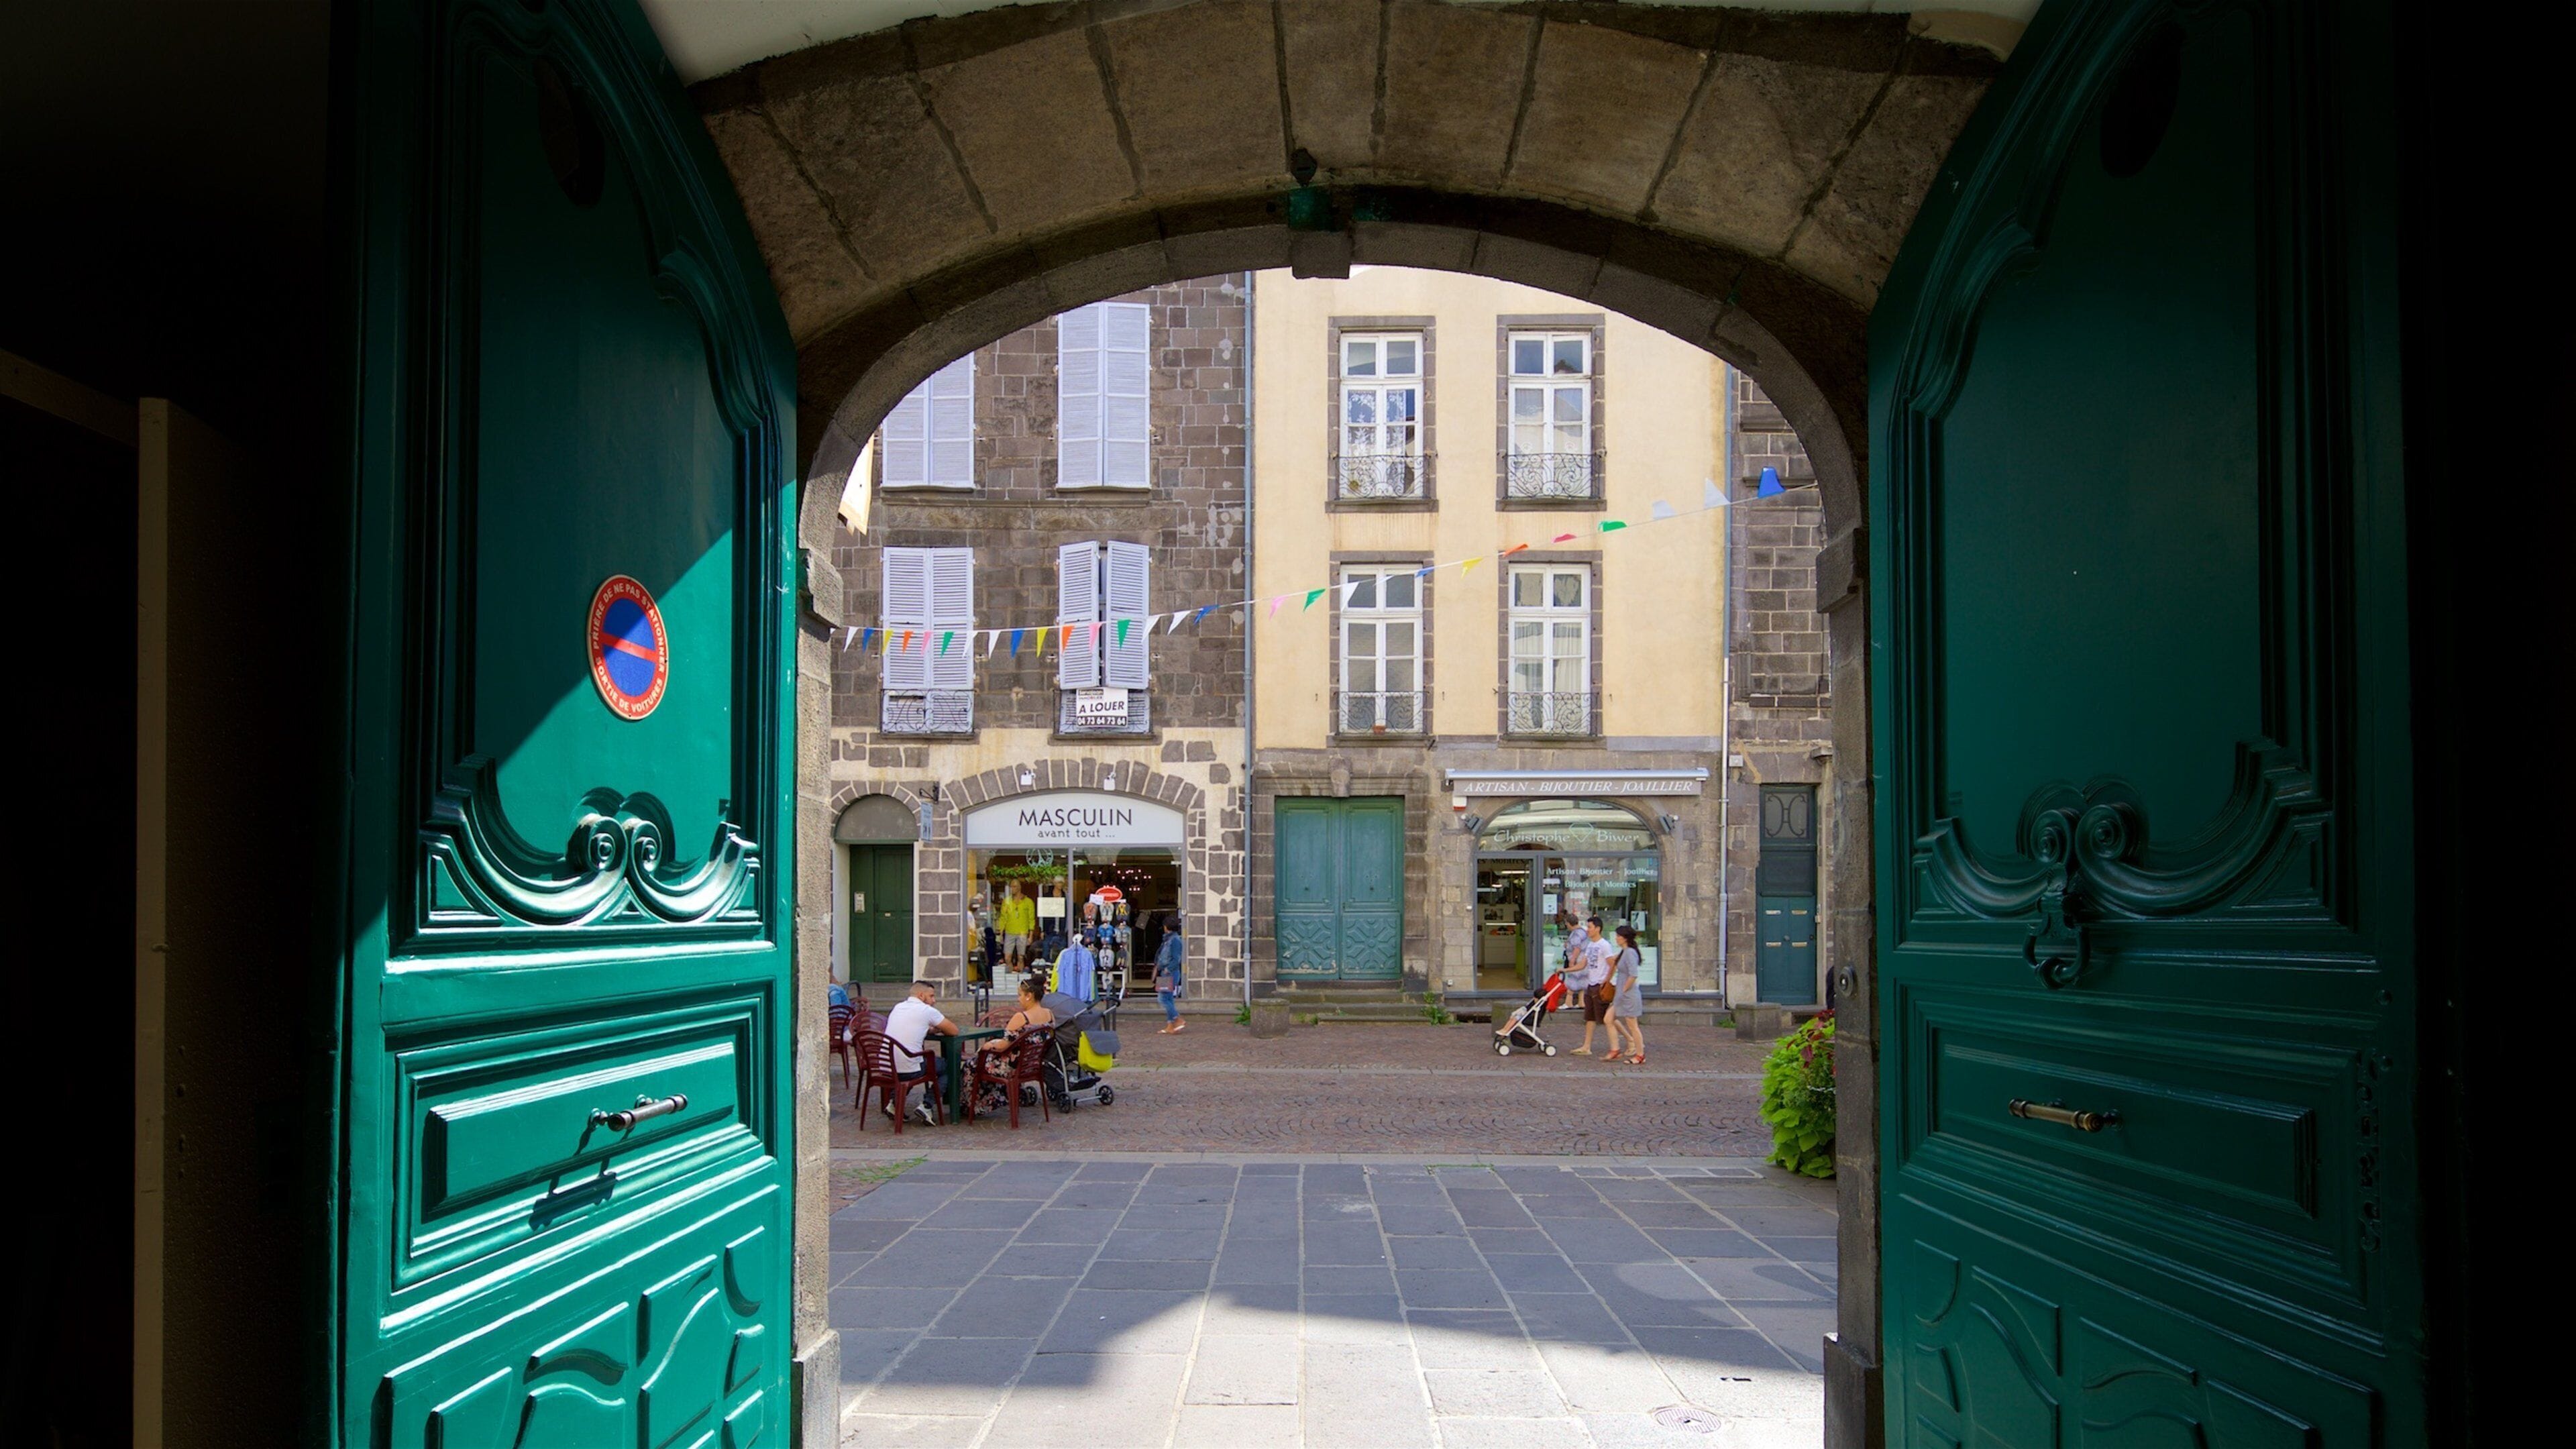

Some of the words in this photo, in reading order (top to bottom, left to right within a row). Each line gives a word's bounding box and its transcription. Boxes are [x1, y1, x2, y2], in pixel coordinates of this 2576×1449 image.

[593, 601, 605, 649] PRIERE
[603, 588, 614, 603] DE
[613, 583, 625, 594] NE
[625, 583, 640, 599] PAS
[641, 595, 665, 673] STATIONNER
[595, 657, 619, 702] SORTIE
[619, 698, 629, 711] DE
[631, 678, 663, 712] VOITURES
[1079, 704, 1086, 714] A
[1089, 701, 1125, 712] LOUER
[1087, 716, 1095, 724] 73
[1096, 716, 1105, 724] 64
[1106, 716, 1115, 724] 73
[1117, 716, 1125, 724] 64
[1464, 782, 1529, 792] ARTISAN
[1539, 781, 1613, 794] BIJOUTIER
[1620, 781, 1693, 794] JOAILLIER
[1018, 808, 1132, 826] MASCULIN
[1038, 828, 1071, 838] avant
[1076, 828, 1100, 838] tout
[1494, 830, 1570, 843] Christophe
[1597, 830, 1640, 843] Biwer
[1546, 867, 1575, 875] Artisan
[1564, 880, 1589, 889] Bijoux
[1605, 880, 1637, 888] Montres
